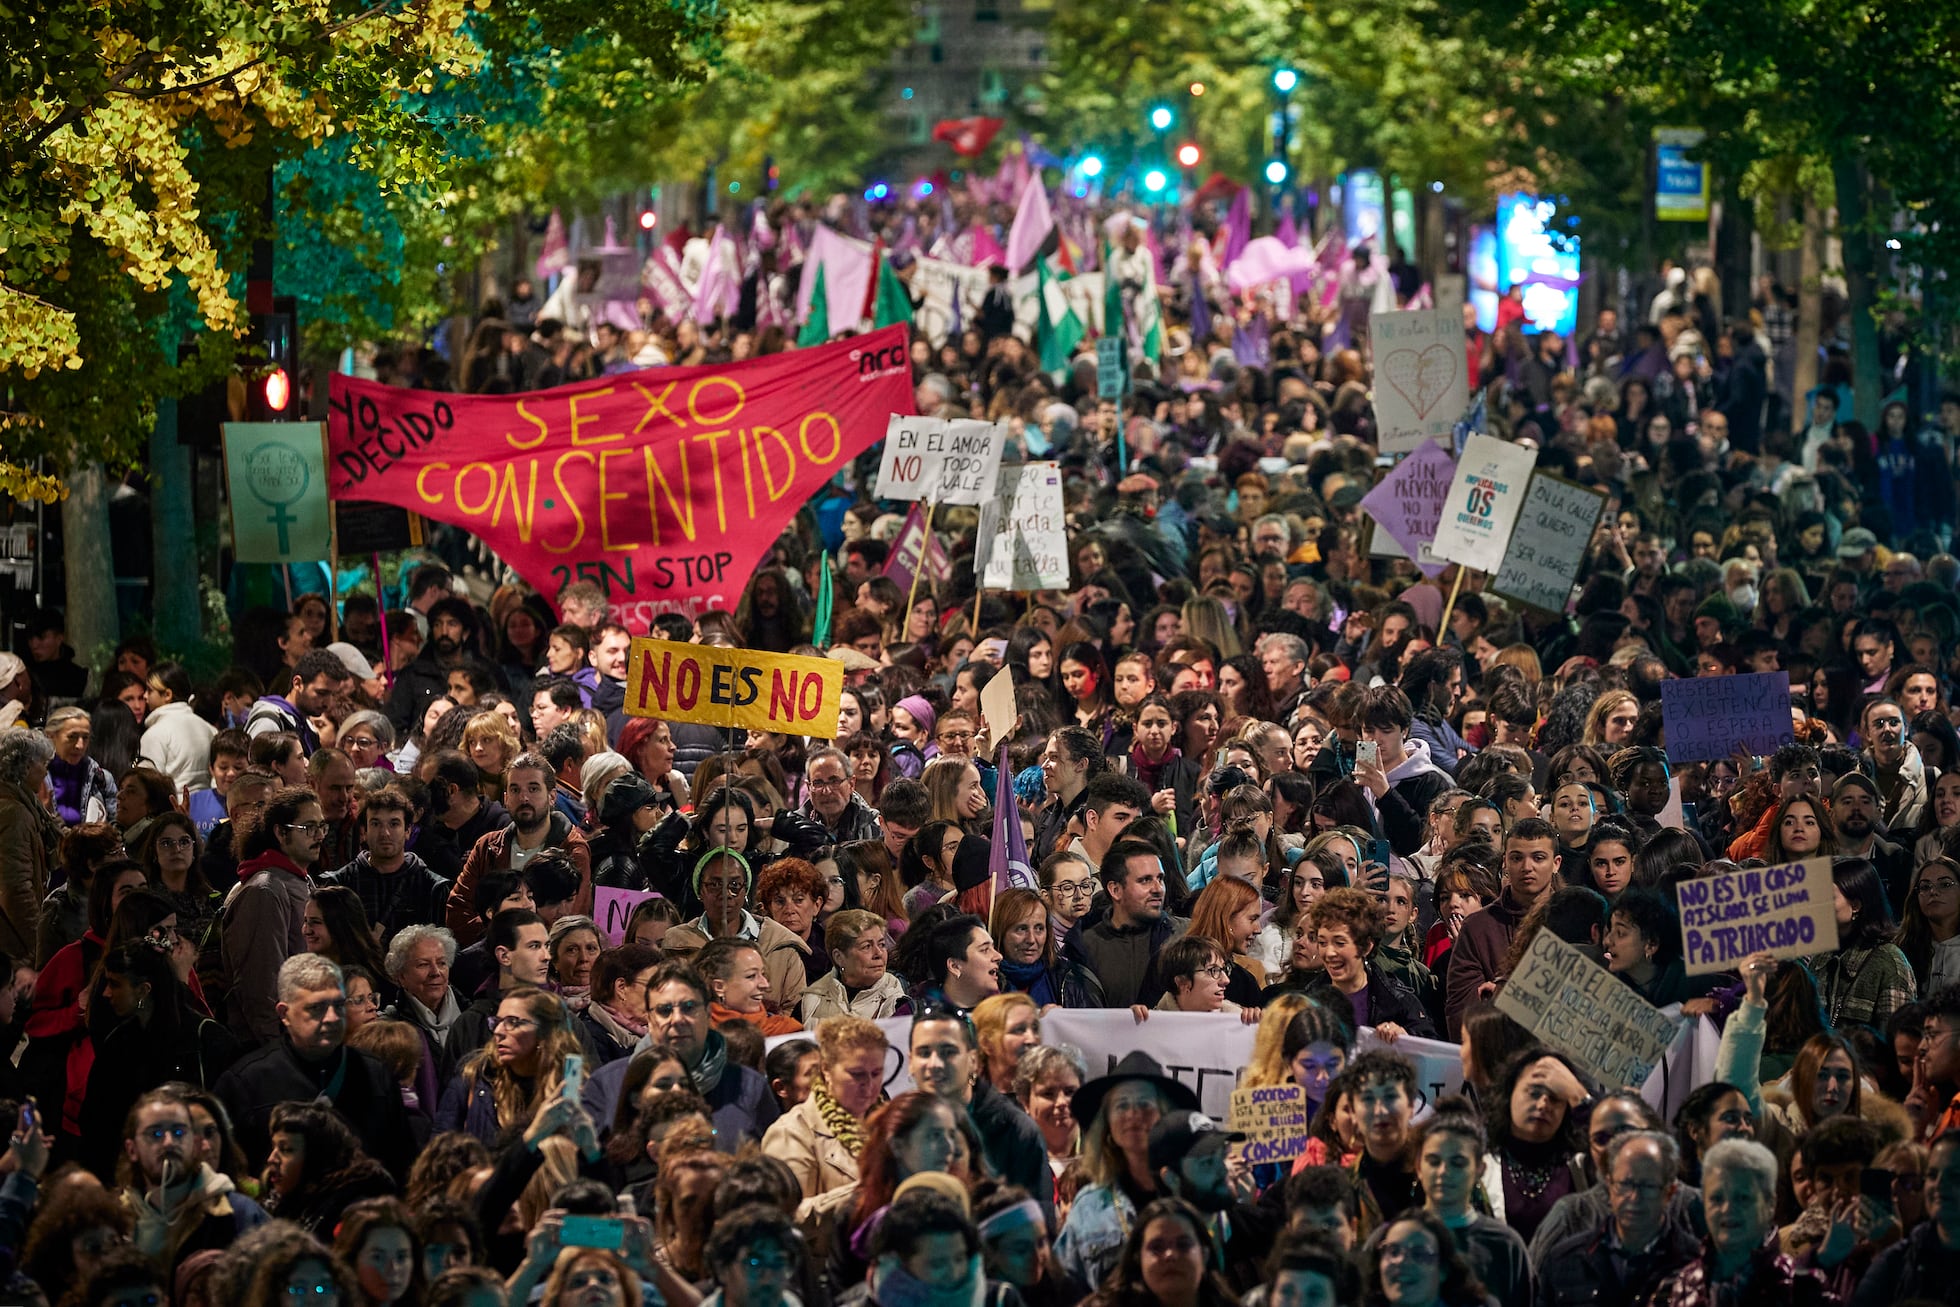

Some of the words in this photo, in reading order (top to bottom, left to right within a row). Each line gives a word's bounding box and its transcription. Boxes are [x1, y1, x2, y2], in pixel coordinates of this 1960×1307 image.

[329, 386, 379, 442] YO
[506, 375, 746, 450] SEXO
[337, 401, 454, 484] DECIDO
[898, 430, 919, 449] EN
[926, 434, 945, 452] EL
[950, 436, 992, 457] AMOR
[890, 456, 922, 482] NO
[942, 457, 983, 473] TODO
[940, 476, 985, 491] VALE
[1403, 502, 1421, 516] NO
[1466, 487, 1496, 518] OS
[1537, 511, 1577, 538] QUIERO
[1515, 543, 1536, 562] SER
[551, 556, 636, 597] 25N
[653, 552, 732, 590] STOP
[638, 649, 701, 712] NO
[710, 664, 764, 706] ES
[768, 668, 824, 723] NO
[1662, 679, 1736, 699] RESPETA
[1667, 693, 1789, 720] EXISTENCIA
[1676, 722, 1690, 739] O
[1707, 715, 1773, 737] ESPERA
[1679, 881, 1709, 908] NO
[1713, 874, 1735, 904] ES
[1738, 872, 1762, 899] UN
[1752, 895, 1770, 917] SE
[1532, 934, 1587, 986] CONTRA
[1584, 971, 1607, 1001] EL
[1607, 983, 1681, 1046] PATRIARCADO
[1523, 959, 1540, 980] Y
[1535, 969, 1561, 996] SU
[1647, 1045, 1664, 1062] Y
[1541, 1003, 1634, 1083] RESISTENCIA
[1241, 1135, 1308, 1162] CONSUMO
